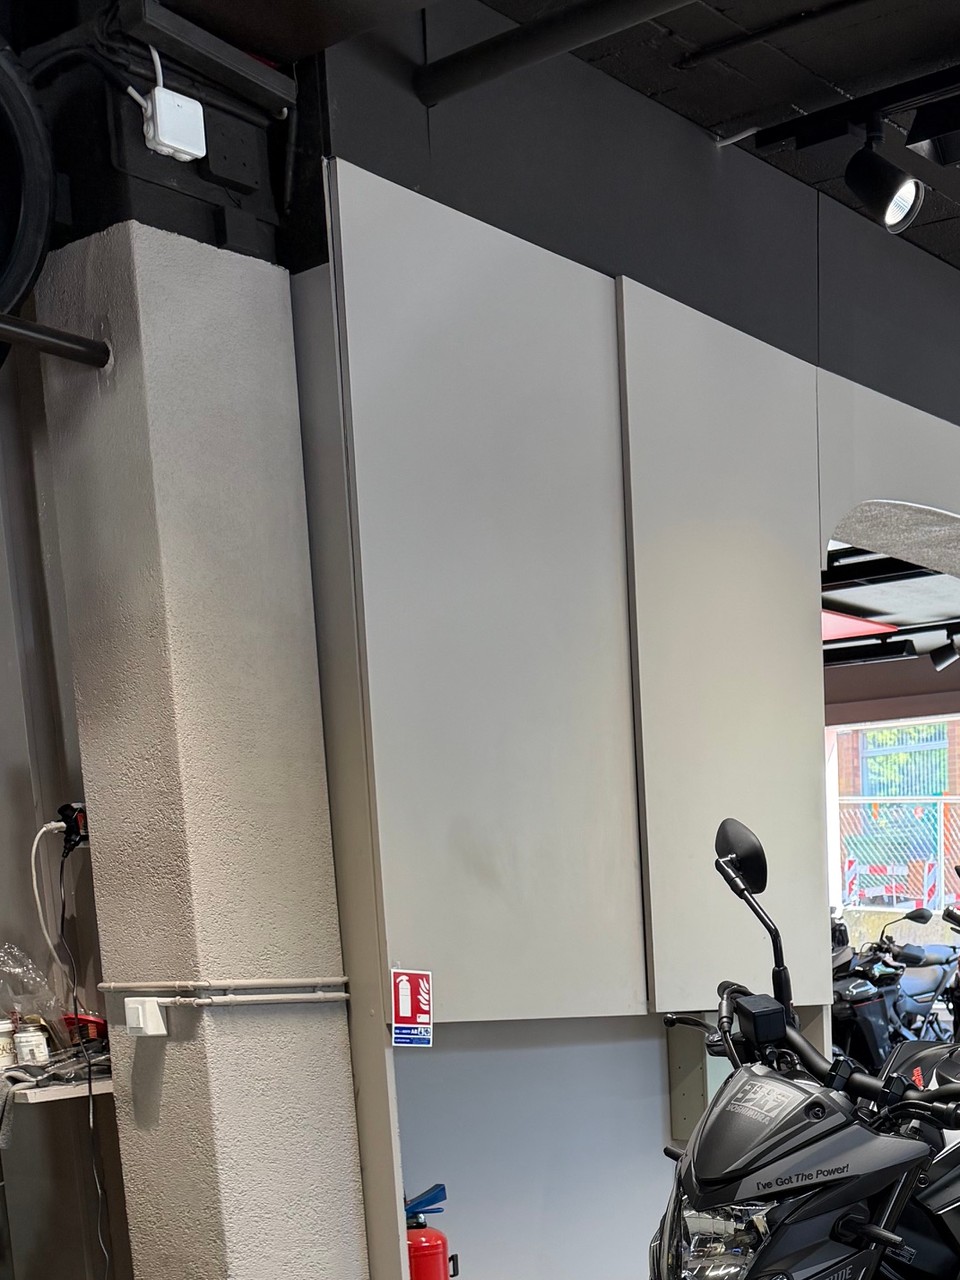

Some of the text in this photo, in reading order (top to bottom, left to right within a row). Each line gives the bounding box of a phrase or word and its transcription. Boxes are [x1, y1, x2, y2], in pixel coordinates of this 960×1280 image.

[726, 1103, 770, 1125] YOSHIMURA
[756, 1163, 849, 1191] I've Got The Power!
